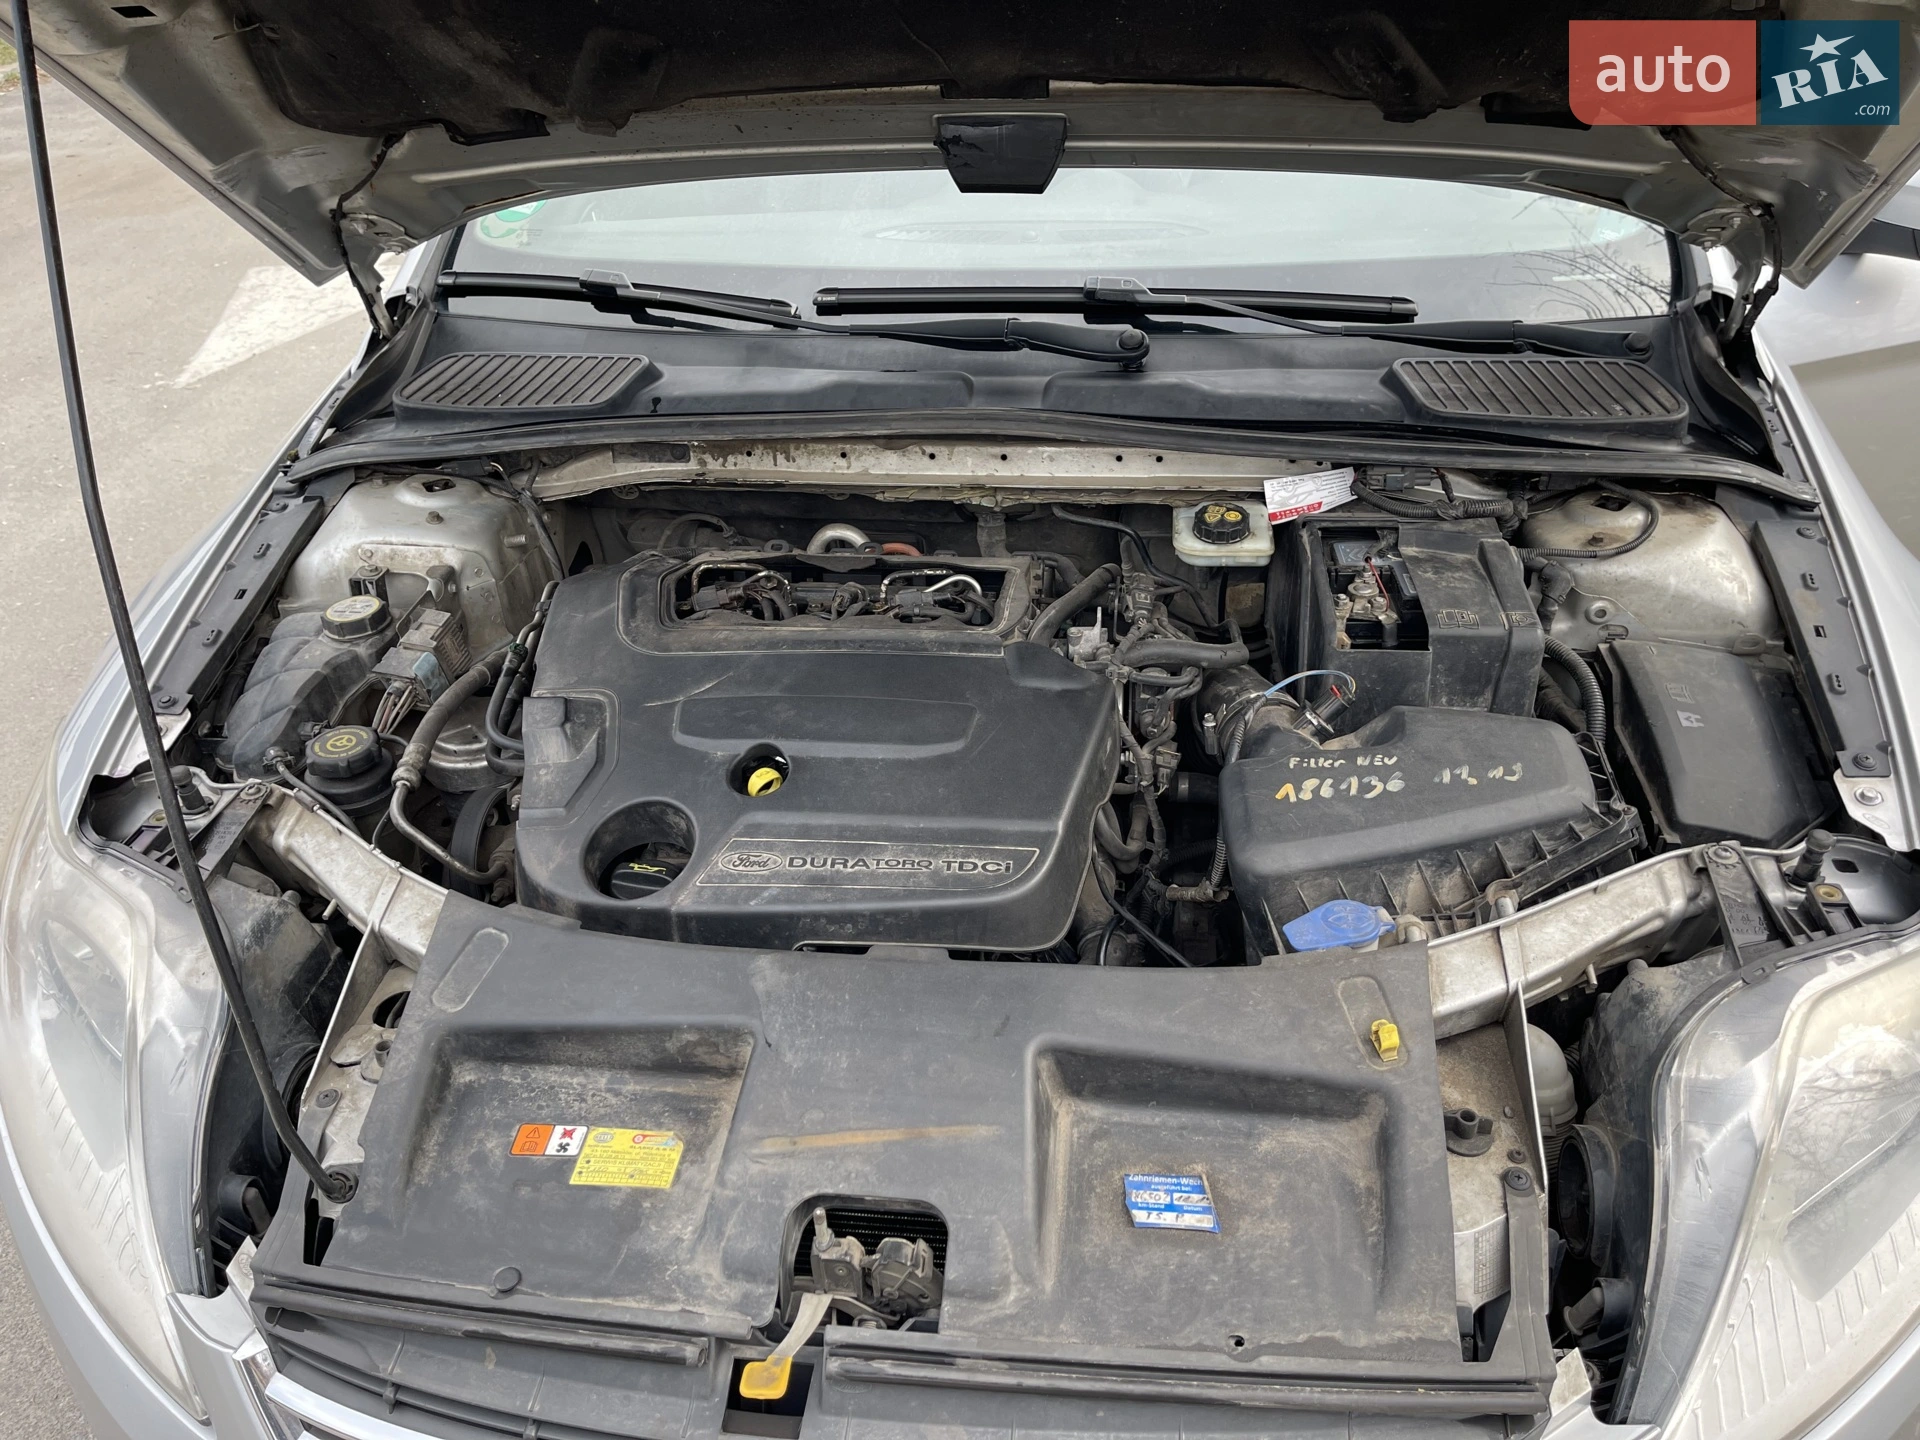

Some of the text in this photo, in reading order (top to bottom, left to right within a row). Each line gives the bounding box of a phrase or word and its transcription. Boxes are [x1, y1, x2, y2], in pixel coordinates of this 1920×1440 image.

[1356, 754, 1398, 766] NEU
[1274, 771, 1406, 803] 186136
[732, 853, 1012, 874] Ford DURATORQ TDCi
